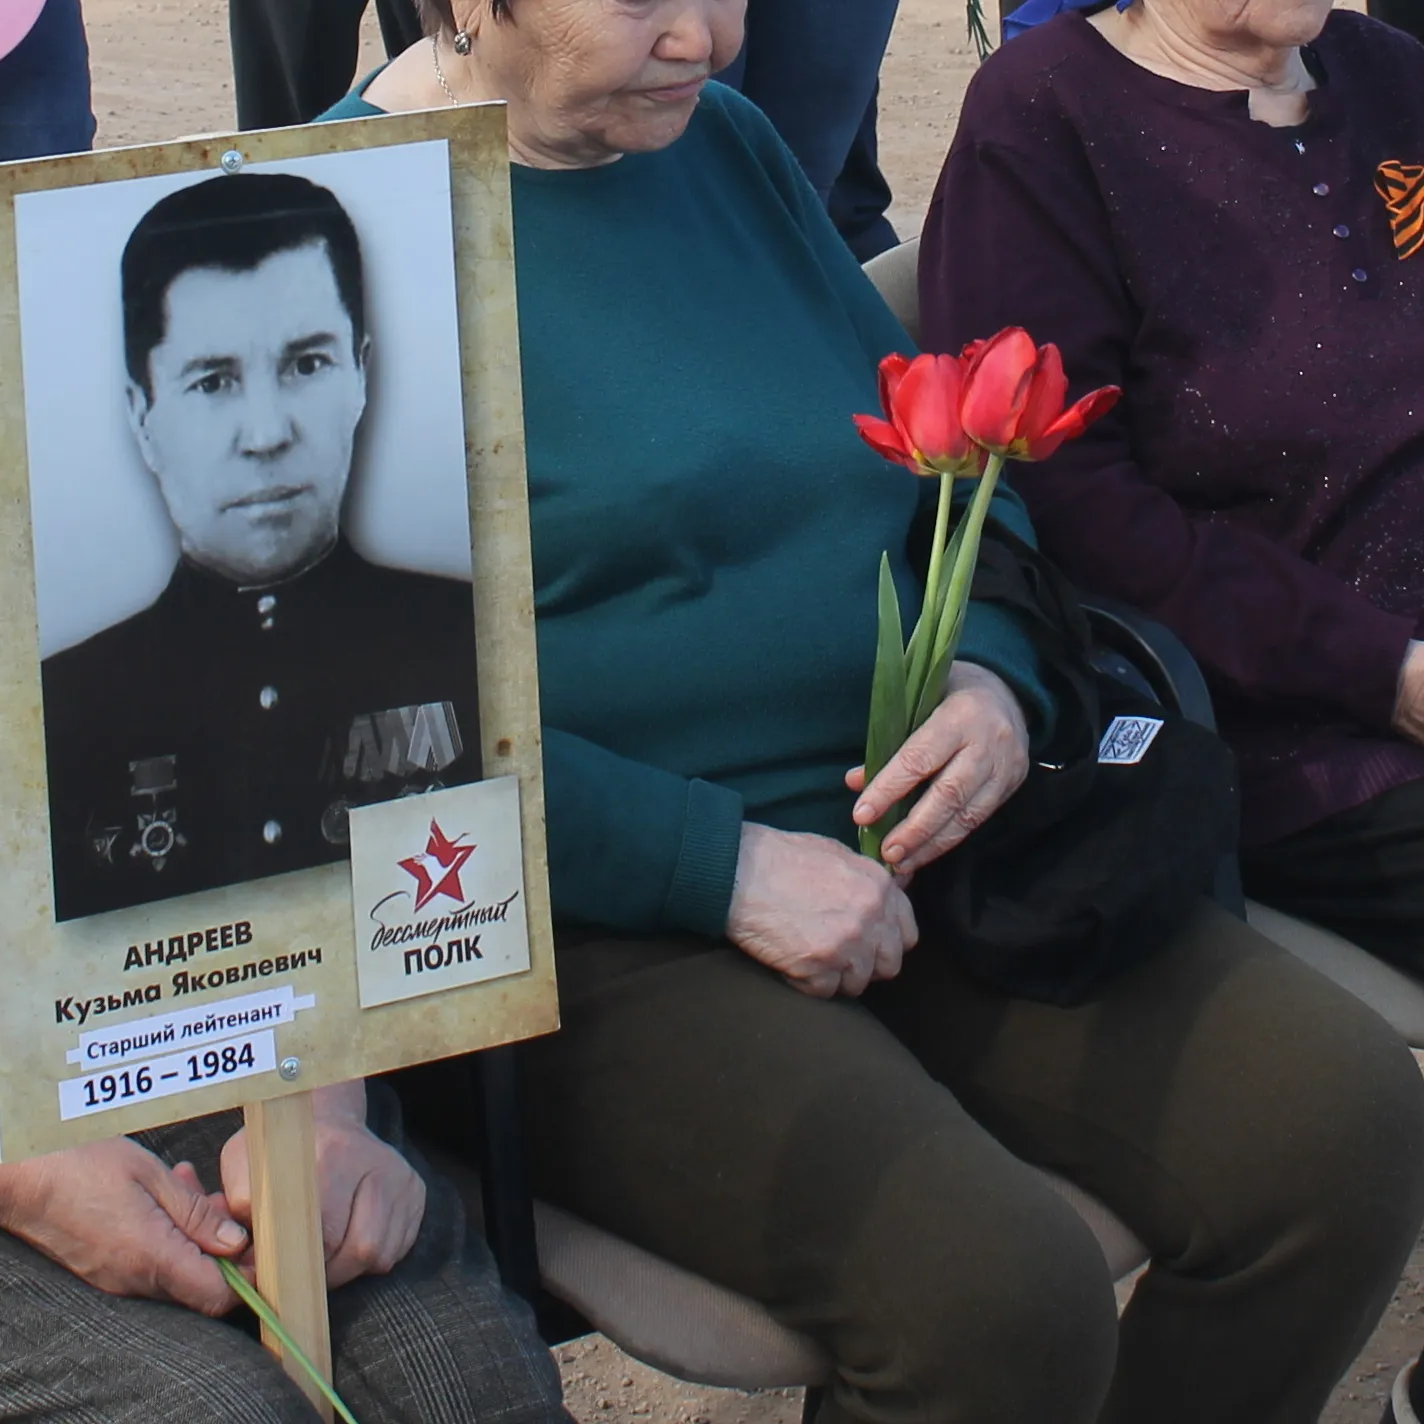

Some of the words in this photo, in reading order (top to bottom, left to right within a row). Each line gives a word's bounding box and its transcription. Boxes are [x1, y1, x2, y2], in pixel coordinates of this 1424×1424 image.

[123, 920, 253, 972] АНДРЕЕВ
[404, 934, 483, 976] ПОЛК
[55, 982, 161, 1025] Кузьма
[172, 947, 323, 997] Яковлевич
[86, 1023, 176, 1060] Старший
[180, 1002, 282, 1040] лейтенант
[83, 1066, 153, 1107] 1916
[187, 1042, 255, 1082] 1984
